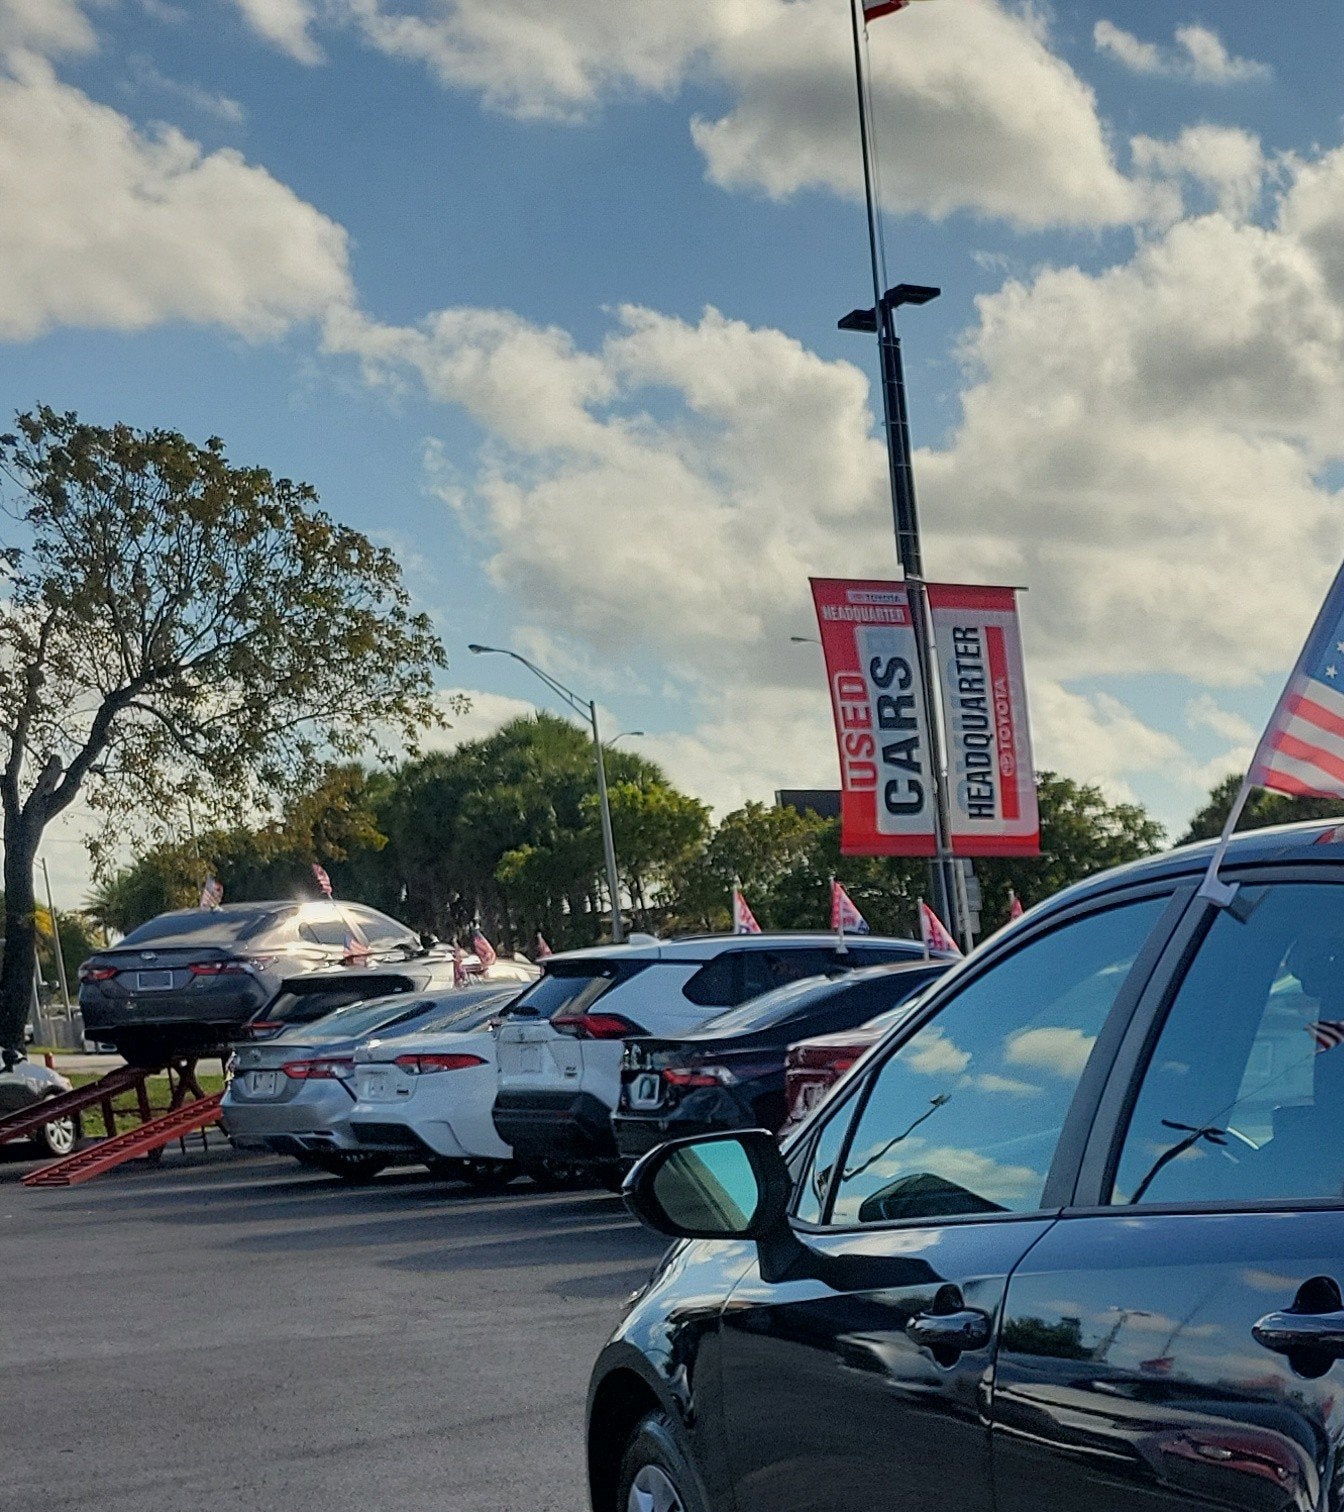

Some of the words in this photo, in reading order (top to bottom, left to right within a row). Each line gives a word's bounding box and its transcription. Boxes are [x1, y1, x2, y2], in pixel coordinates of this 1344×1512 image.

[838, 674, 878, 791] USED
[871, 656, 924, 816] CARS
[953, 625, 995, 819] HEADQUARTER
[994, 677, 1013, 750] TOYOTA
